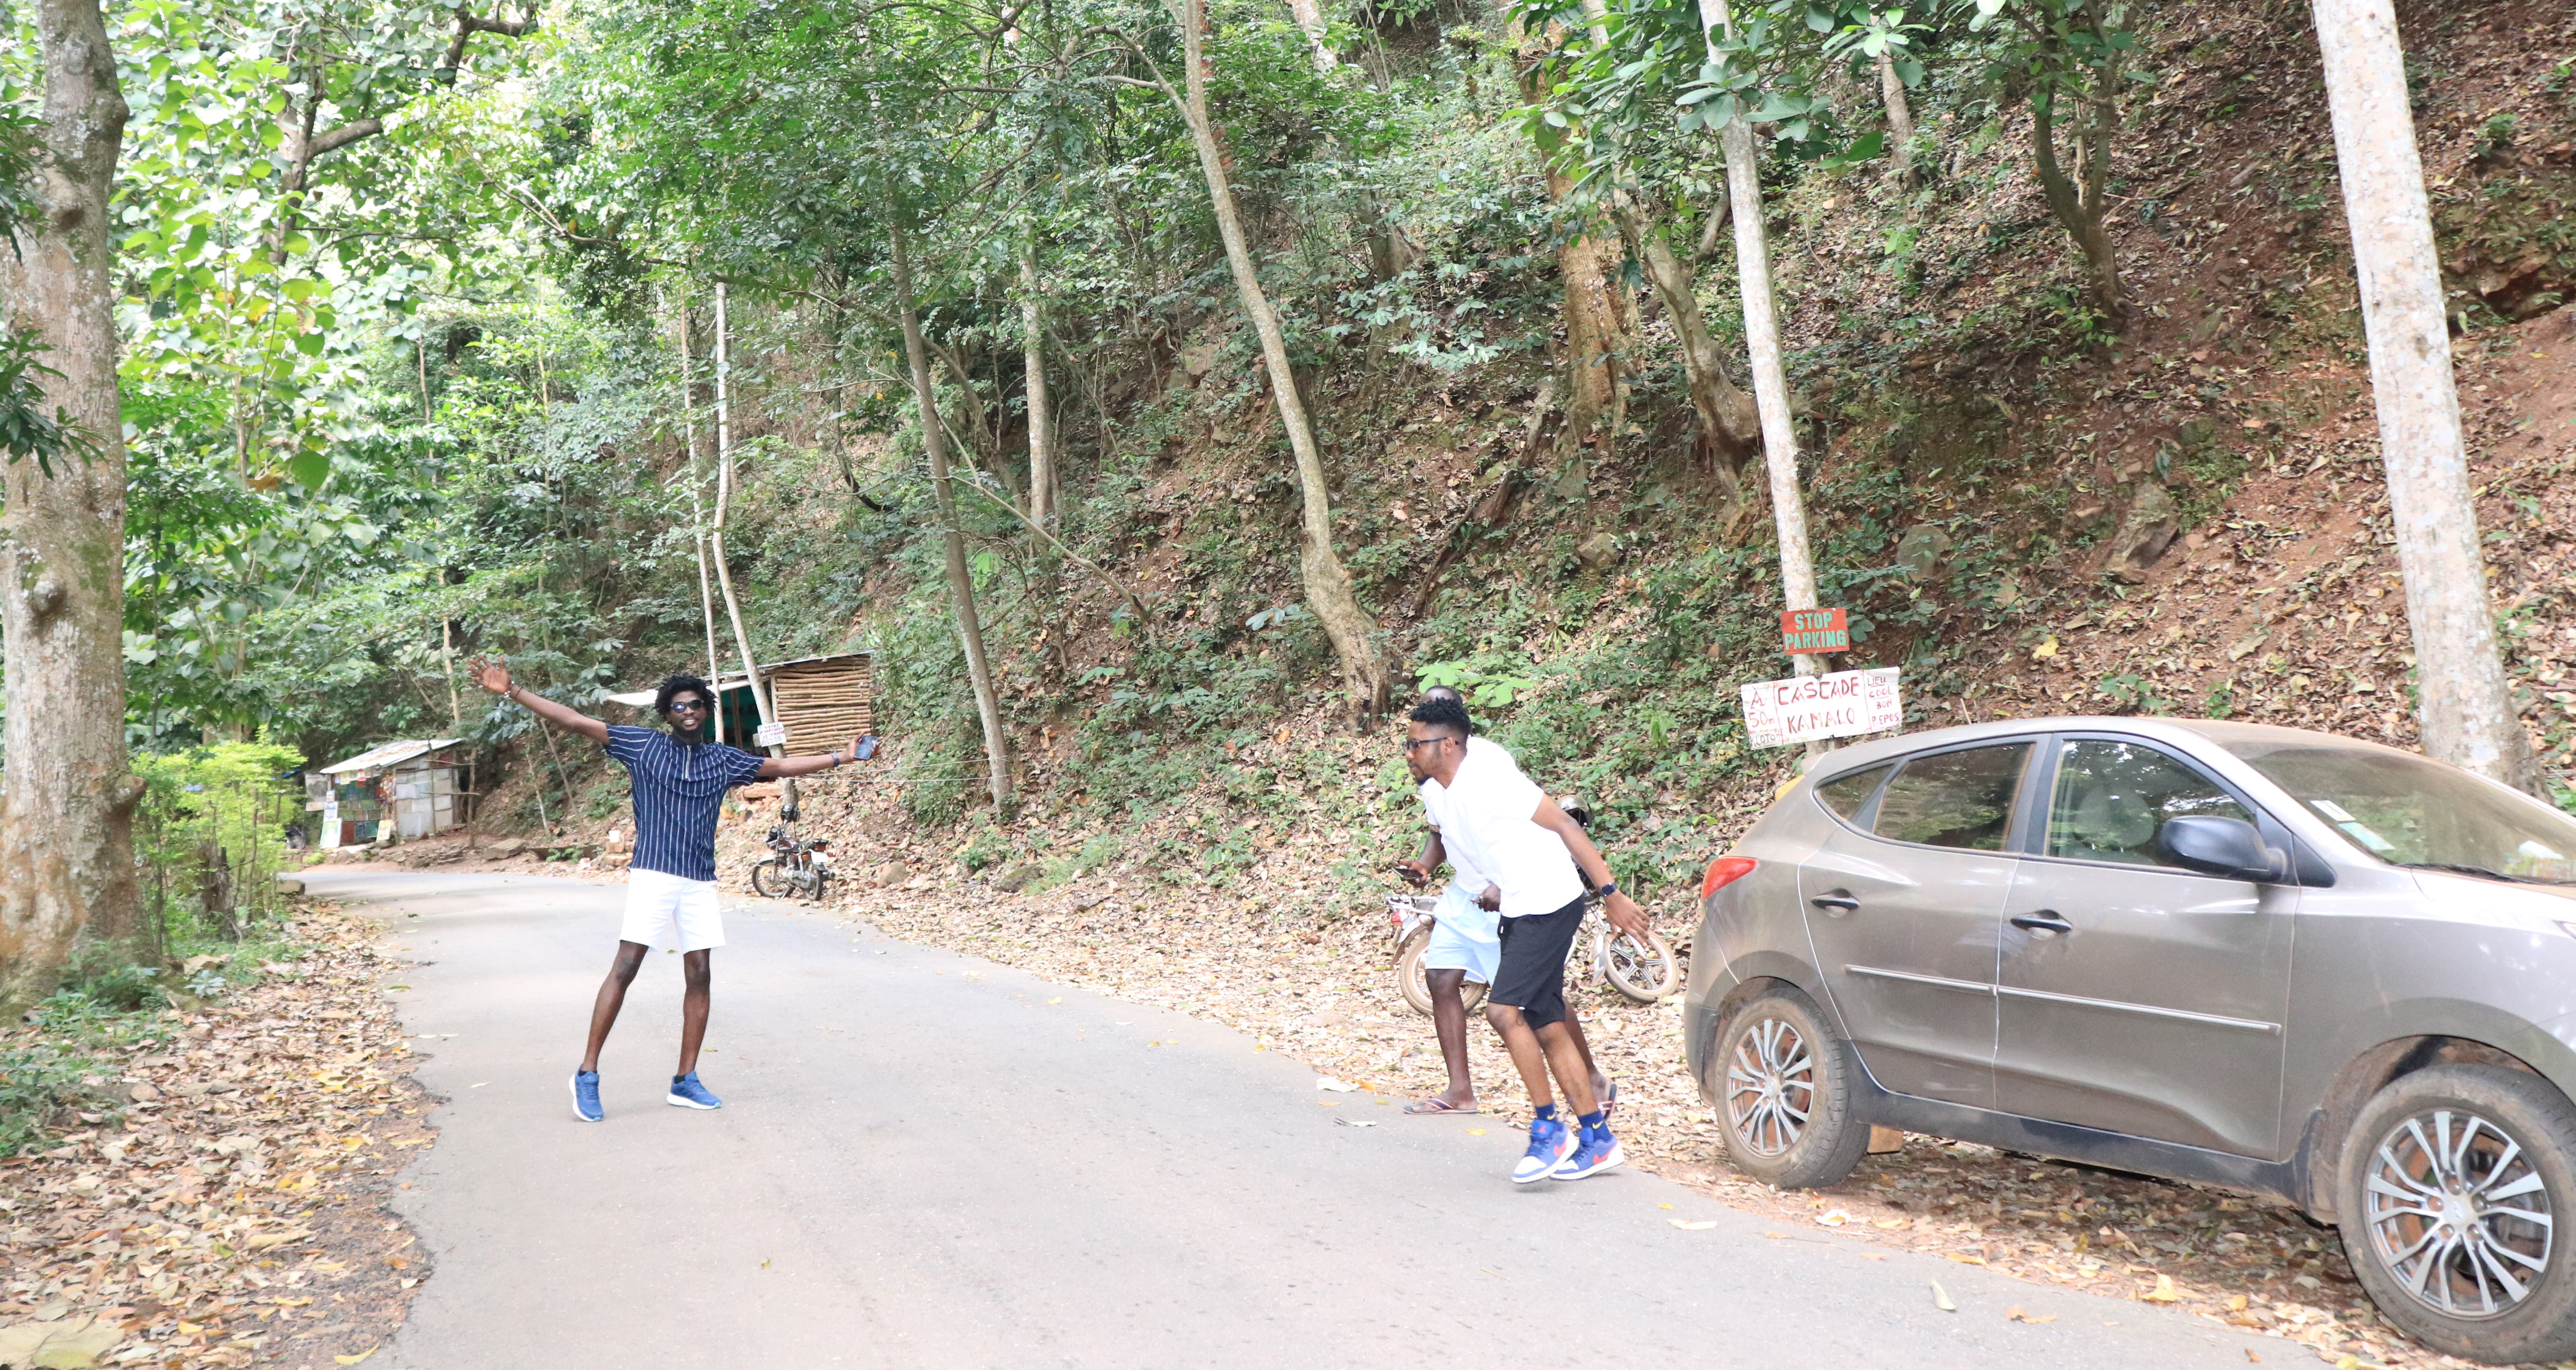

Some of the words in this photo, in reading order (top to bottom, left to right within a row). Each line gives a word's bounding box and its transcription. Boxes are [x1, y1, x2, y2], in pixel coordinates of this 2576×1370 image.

[1794, 612, 1832, 630] STOP
[1785, 630, 1847, 650] PARKING
[1867, 677, 1887, 686] LIEU
[1778, 677, 1859, 705] CASCADE
[1869, 686, 1894, 697] COOL
[1877, 699, 1892, 709] BON
[1787, 707, 1855, 734] KAMALO
[1872, 712, 1900, 726] REPOS
